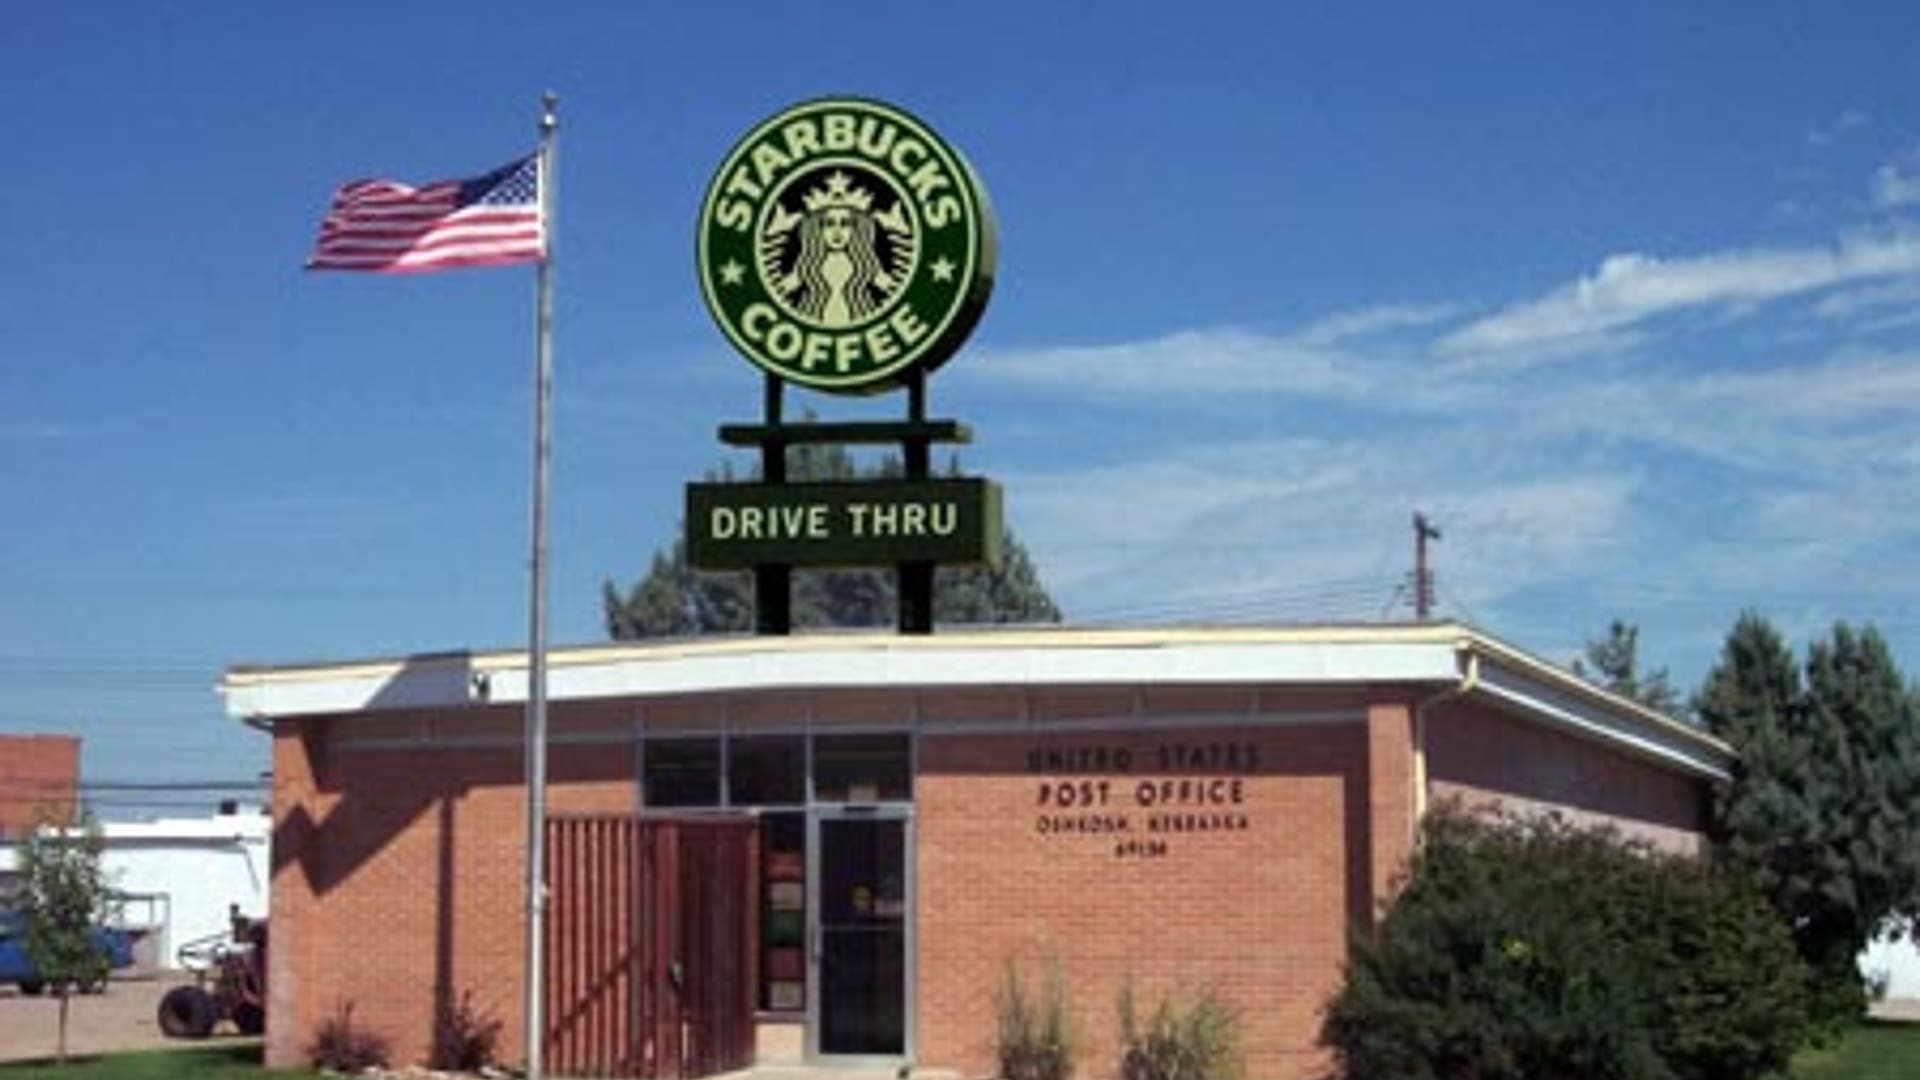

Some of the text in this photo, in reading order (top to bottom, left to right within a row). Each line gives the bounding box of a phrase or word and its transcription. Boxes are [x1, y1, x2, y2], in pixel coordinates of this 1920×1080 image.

[716, 114, 961, 232] STARBUCKS
[740, 303, 929, 372] COFFEE
[711, 503, 957, 539] DRIVE THRU
[1027, 742, 1262, 771] UNITED STATES
[1038, 779, 1243, 806] POST OFFICE
